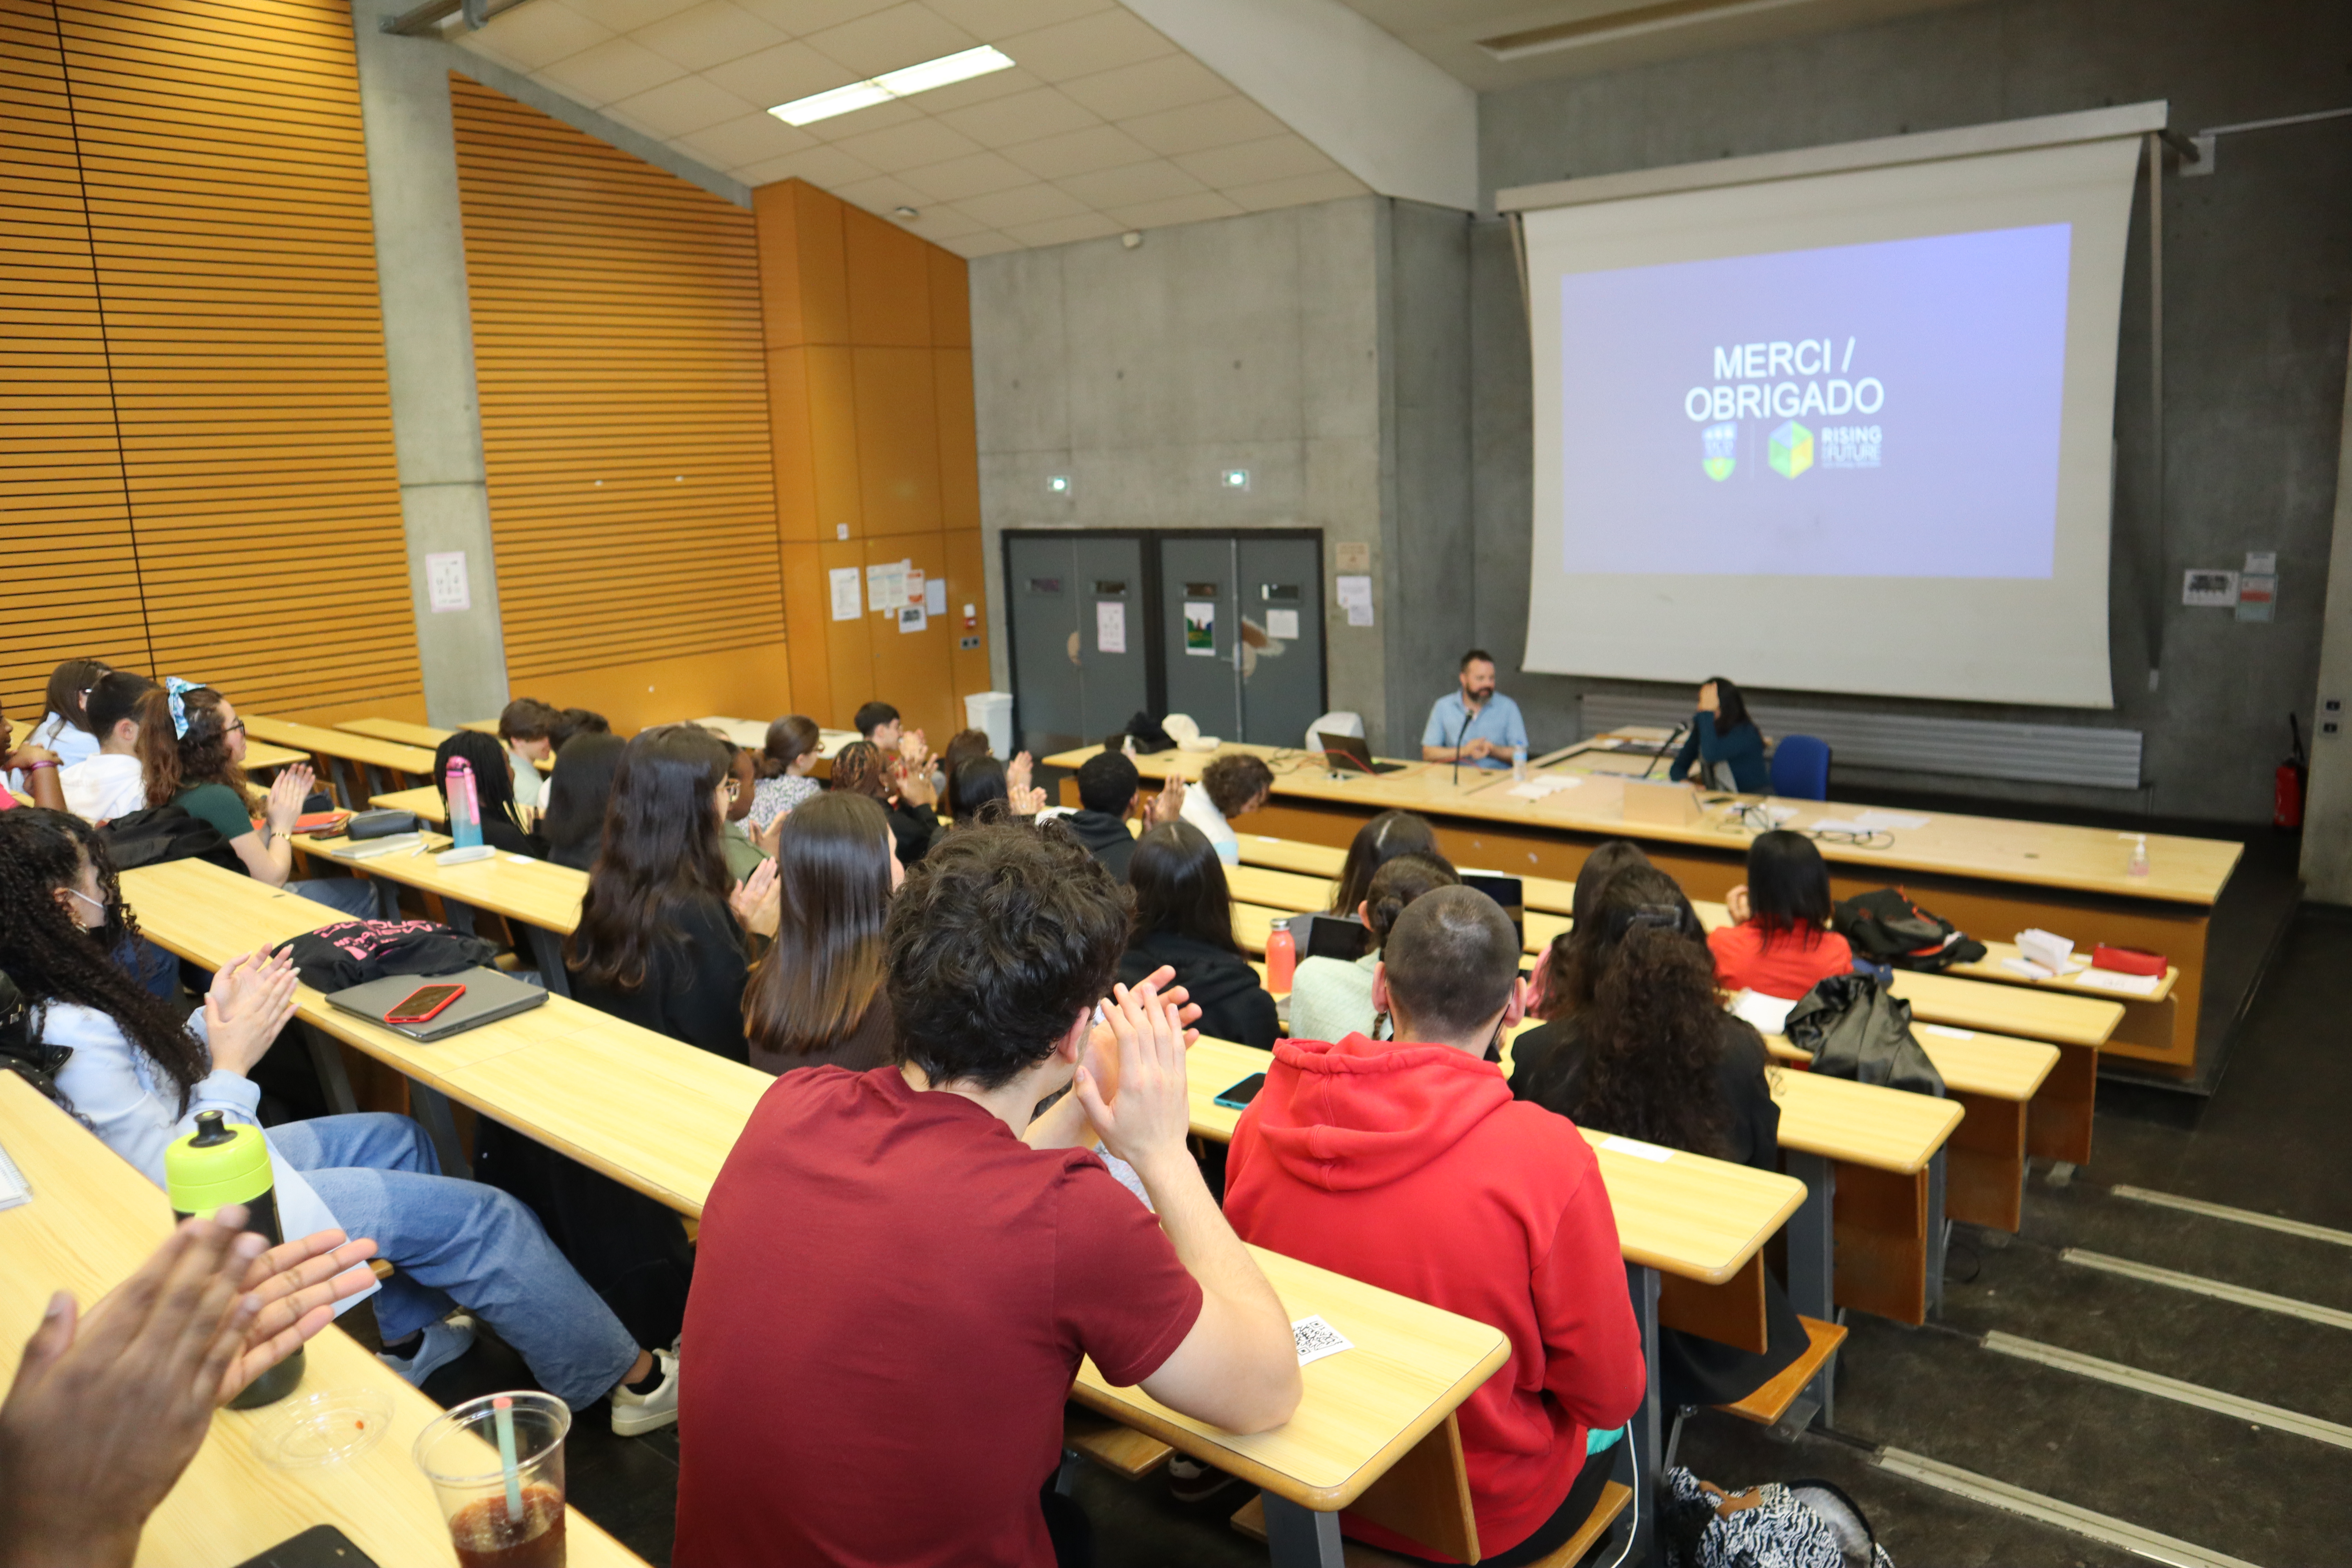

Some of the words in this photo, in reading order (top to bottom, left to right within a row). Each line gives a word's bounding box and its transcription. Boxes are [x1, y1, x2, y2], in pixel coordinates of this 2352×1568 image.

[1714, 338, 1831, 380] MERCI
[1842, 336, 1855, 373] /
[1685, 377, 1885, 421] OBRIGADO
[1822, 425, 1882, 444] RISING
